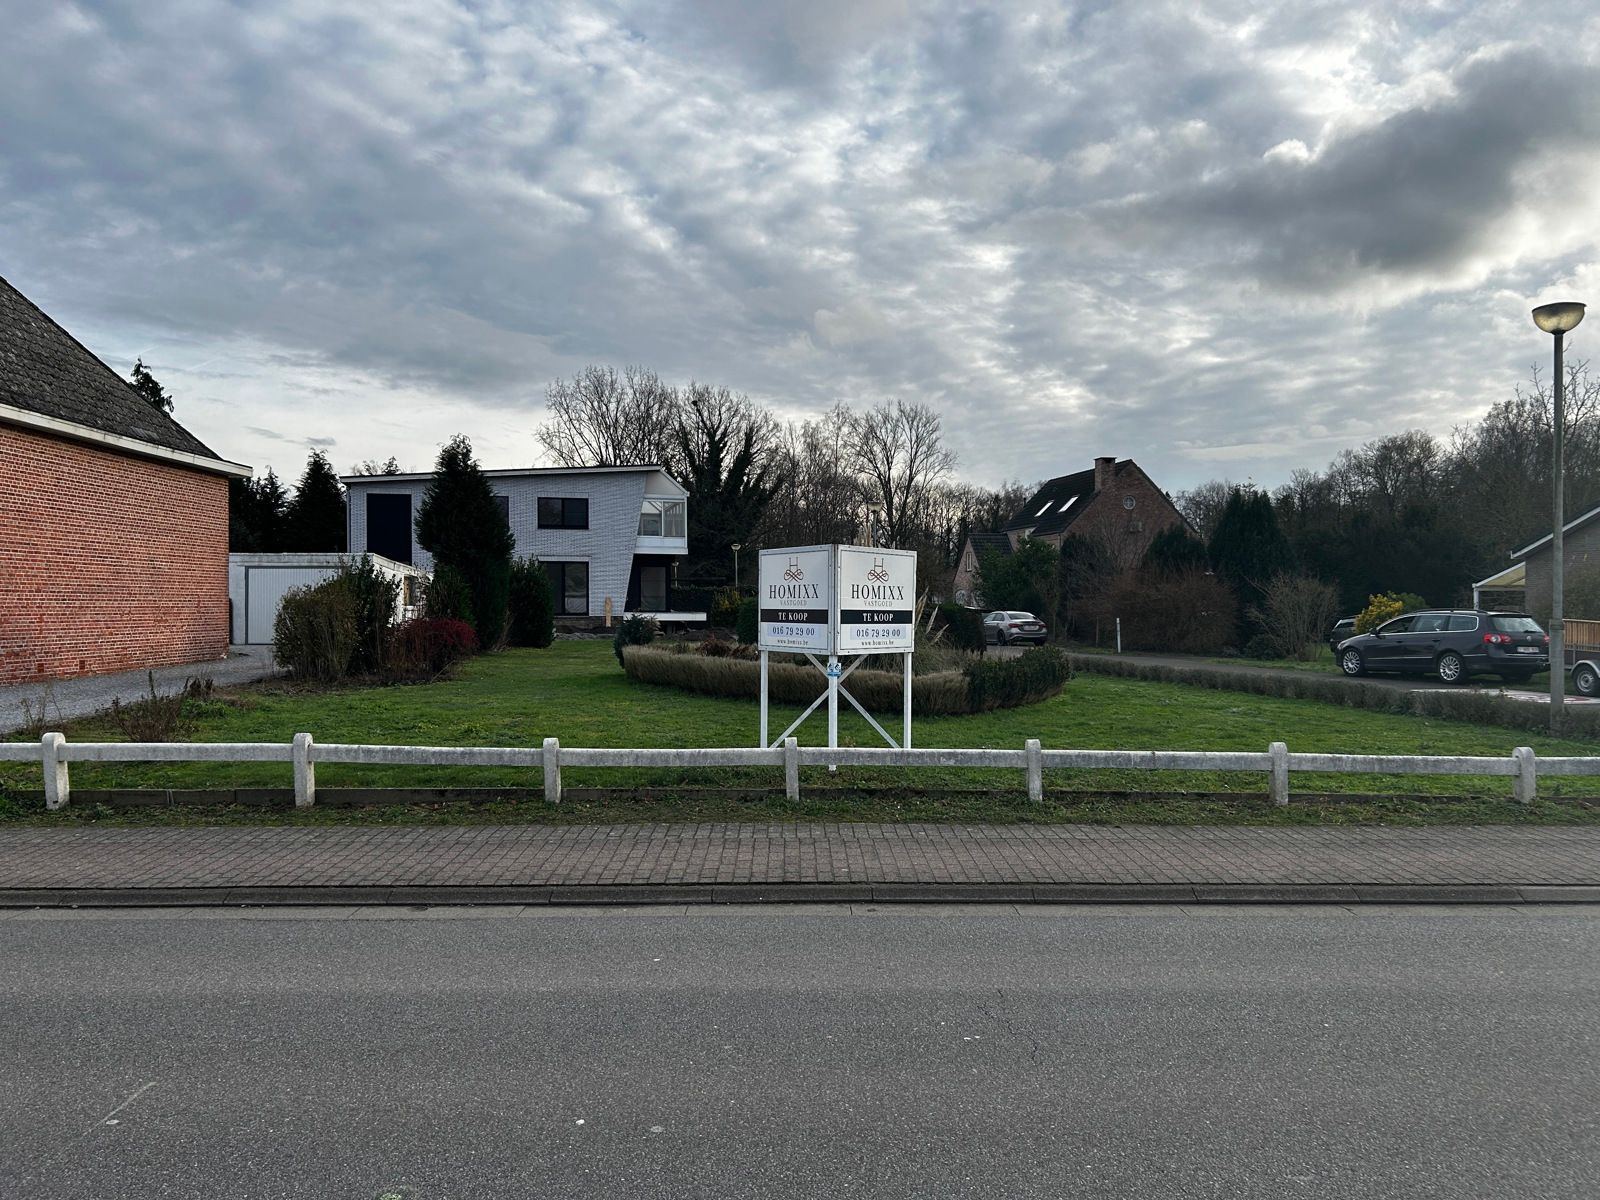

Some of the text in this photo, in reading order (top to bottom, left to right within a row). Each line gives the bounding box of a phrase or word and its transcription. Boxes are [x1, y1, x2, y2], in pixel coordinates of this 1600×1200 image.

[769, 584, 819, 599] HOMIXX
[851, 584, 904, 600] HOMIXX
[778, 612, 808, 621] TE KOOP
[863, 613, 893, 621] TE KOOP
[773, 626, 815, 636] 016 79 29 00
[856, 628, 900, 637] 016 79 29 00
